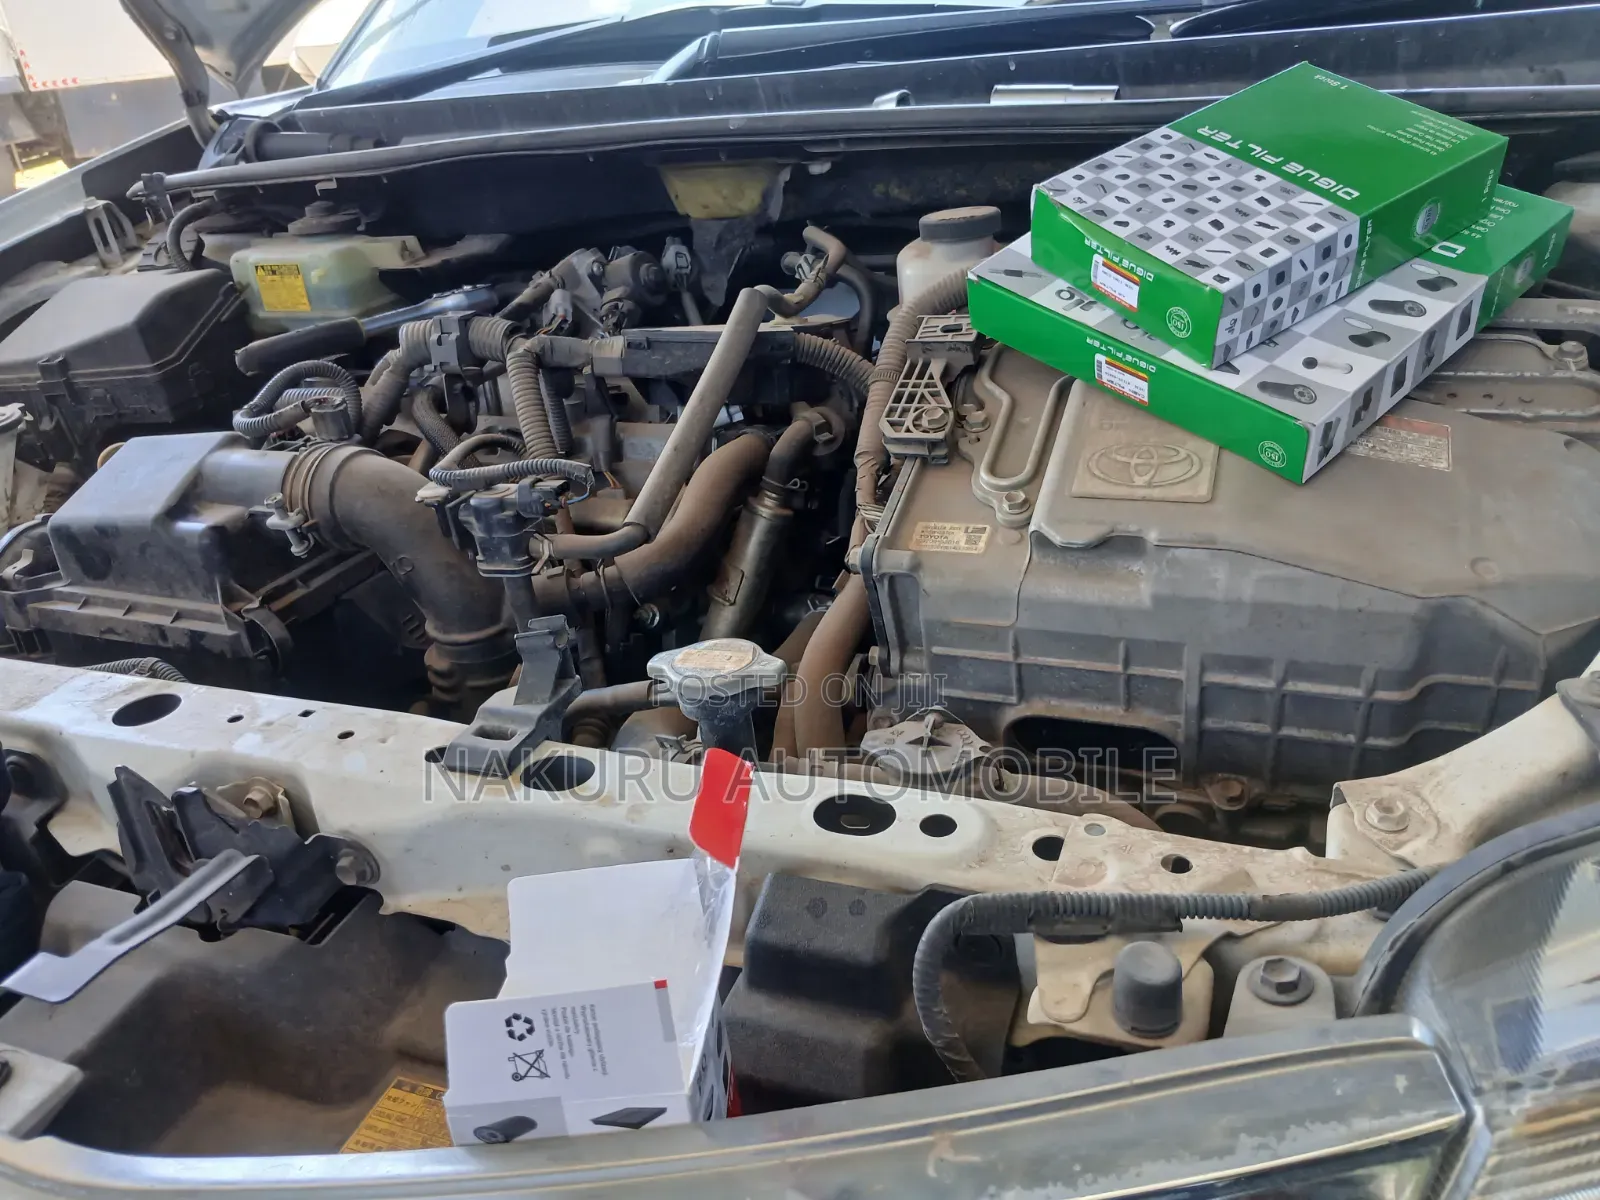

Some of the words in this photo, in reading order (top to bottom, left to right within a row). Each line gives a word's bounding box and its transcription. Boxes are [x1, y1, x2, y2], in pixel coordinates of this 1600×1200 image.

[1196, 125, 1284, 165] FILTER
[1281, 161, 1361, 201] DIGUE
[1084, 237, 1120, 263] FILTER
[1121, 258, 1155, 282] DIGUE
[1172, 319, 1184, 331] ISO
[1085, 336, 1123, 359] FILTER
[1124, 353, 1157, 373] DIGUE
[1265, 451, 1279, 462] ISO
